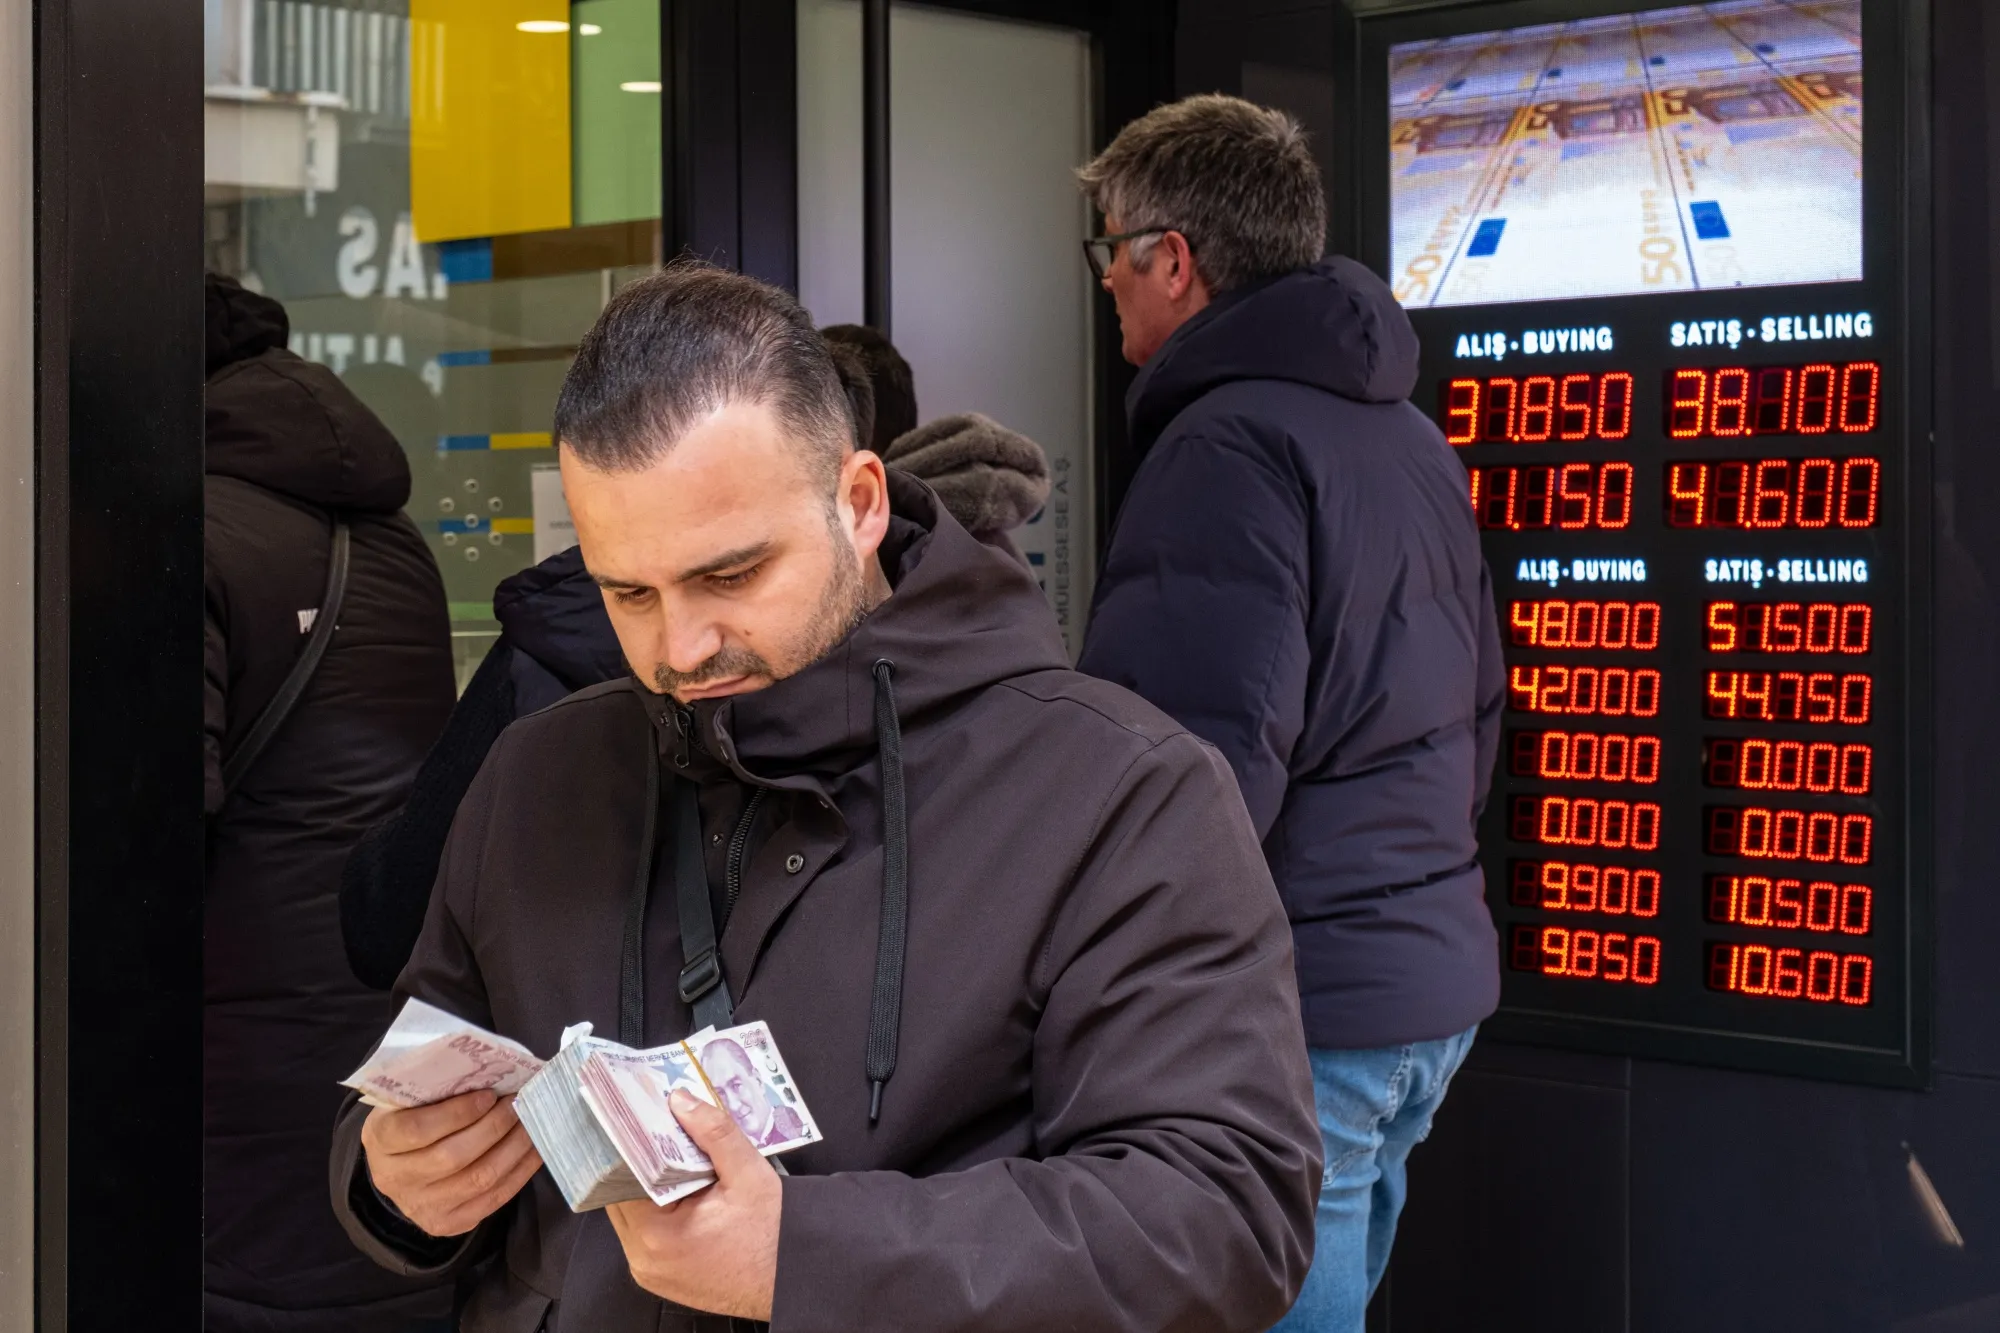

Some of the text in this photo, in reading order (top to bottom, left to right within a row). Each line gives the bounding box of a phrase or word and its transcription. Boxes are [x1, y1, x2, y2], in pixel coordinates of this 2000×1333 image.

[1522, 326, 1613, 355] BUYING
[1670, 312, 1873, 350] SATIŞ SELLING
[1447, 372, 1633, 445] 37.850
[1671, 362, 1879, 438] 38.100
[1670, 458, 1879, 528] 41.600
[1572, 559, 1646, 582] BUYING
[1705, 559, 1868, 589] SATIŞ SELLING
[1511, 601, 1661, 650] 48.000
[1707, 602, 1872, 654] 51.500
[1511, 666, 1661, 717] 42.000
[1707, 672, 1872, 724] 44.750
[1540, 732, 1661, 784] 0.000
[1739, 739, 1872, 794] 0.000
[1540, 797, 1661, 851] 0.000
[1739, 807, 1872, 864] 0.000
[1541, 862, 1661, 917] 9.900
[1728, 876, 1872, 935] 10.500
[1541, 927, 1661, 985] 9.850
[1728, 944, 1872, 1005] 10.600
[449, 1034, 493, 1059] 200
